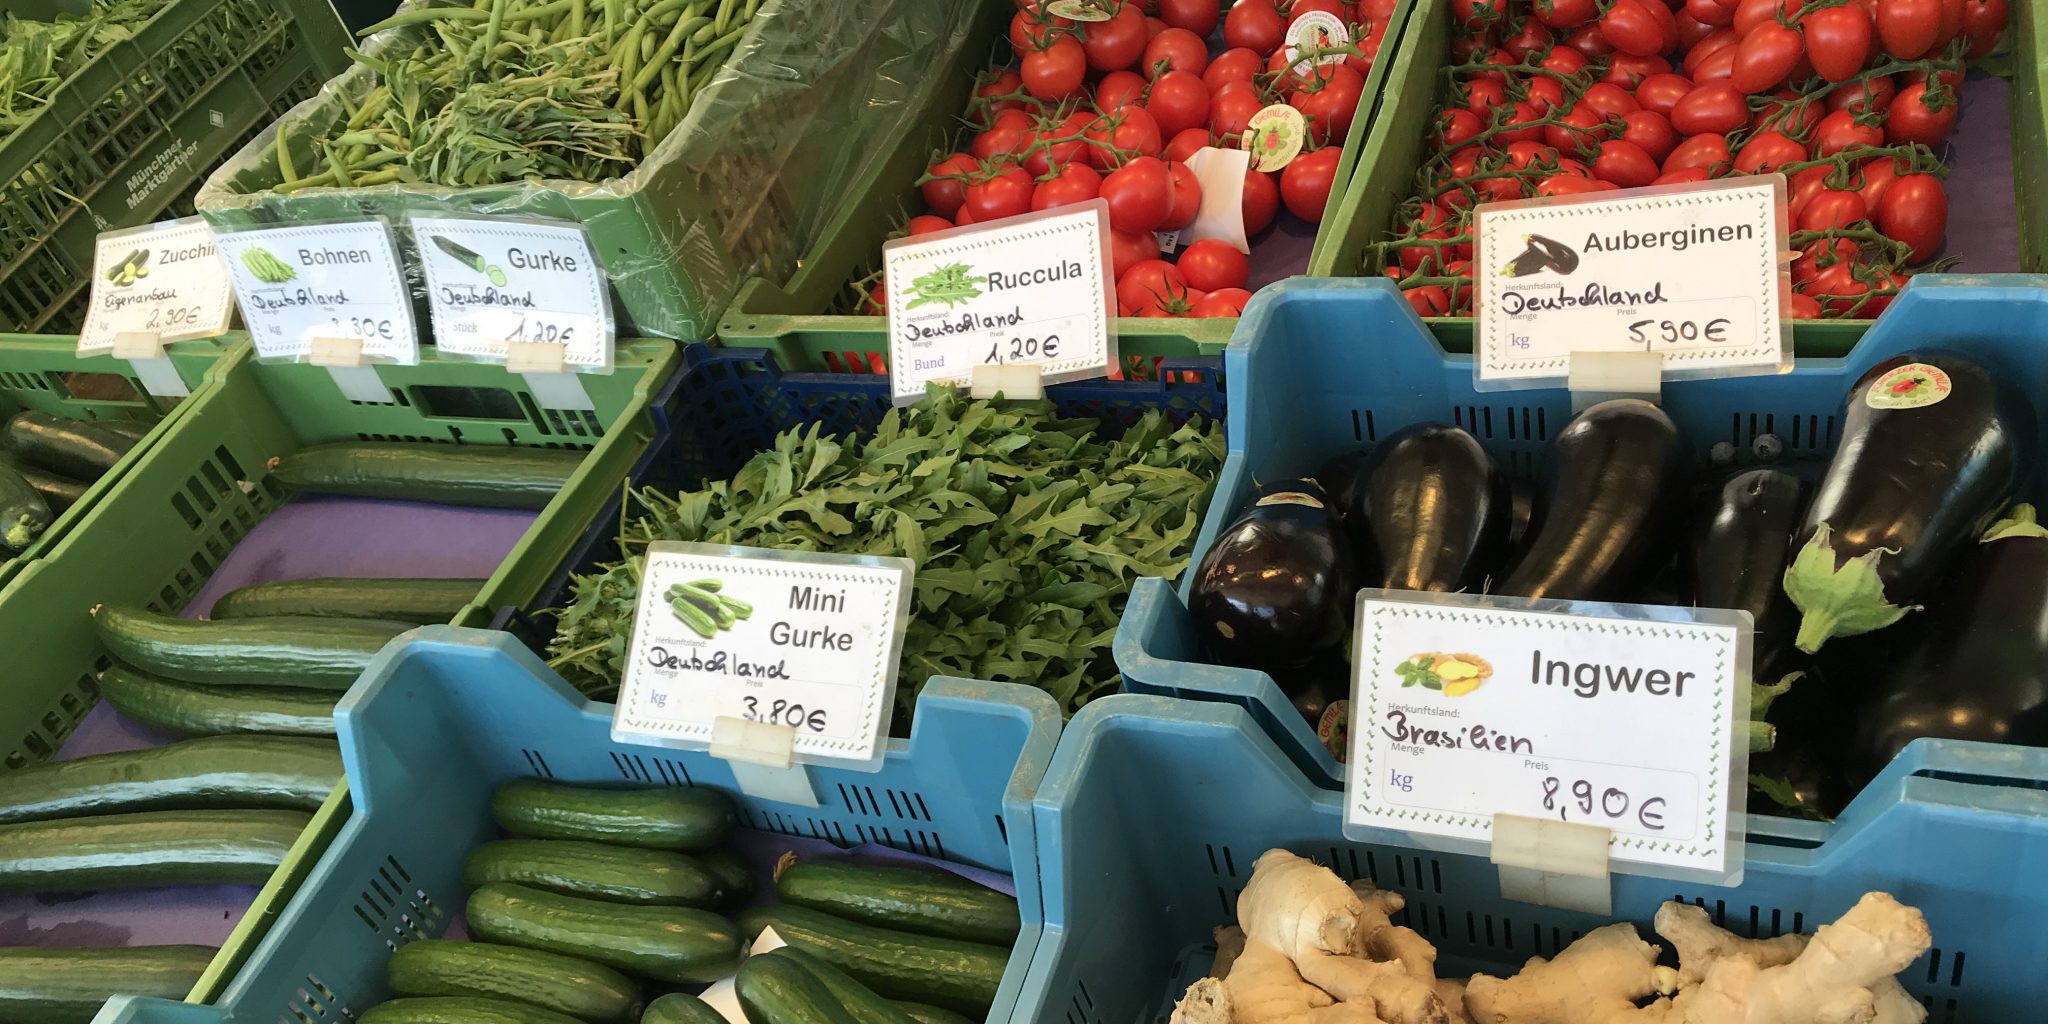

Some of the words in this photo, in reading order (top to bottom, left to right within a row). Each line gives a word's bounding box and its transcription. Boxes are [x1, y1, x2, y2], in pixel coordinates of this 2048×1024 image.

[126, 137, 183, 192] Münchner
[126, 140, 198, 210] Marktgärtner
[1583, 222, 1754, 253] Auberginen
[298, 248, 372, 267] Bohnen
[507, 247, 578, 273] Gurke
[988, 259, 1083, 292] Ruccula
[1501, 281, 1668, 315] Deutschland
[1616, 307, 1637, 316] Preis
[904, 305, 1024, 341] Deutschland
[984, 334, 1060, 365] 1,20€
[1511, 333, 1530, 349] kg
[914, 356, 945, 371] Bund
[789, 585, 846, 613] Mini
[769, 621, 853, 651] Gurke
[647, 646, 791, 680] Deutschland
[1531, 649, 1696, 698] Ingwer
[650, 689, 668, 708] kg
[1388, 702, 1461, 718] Herkunftsland:
[742, 695, 827, 733] 3,80€
[1380, 710, 1533, 754] Brasilien
[1390, 742, 1425, 756] Menge
[1390, 768, 1413, 792] kg
[1524, 759, 1549, 771] Preis
[1541, 776, 1667, 830] 8,90€
